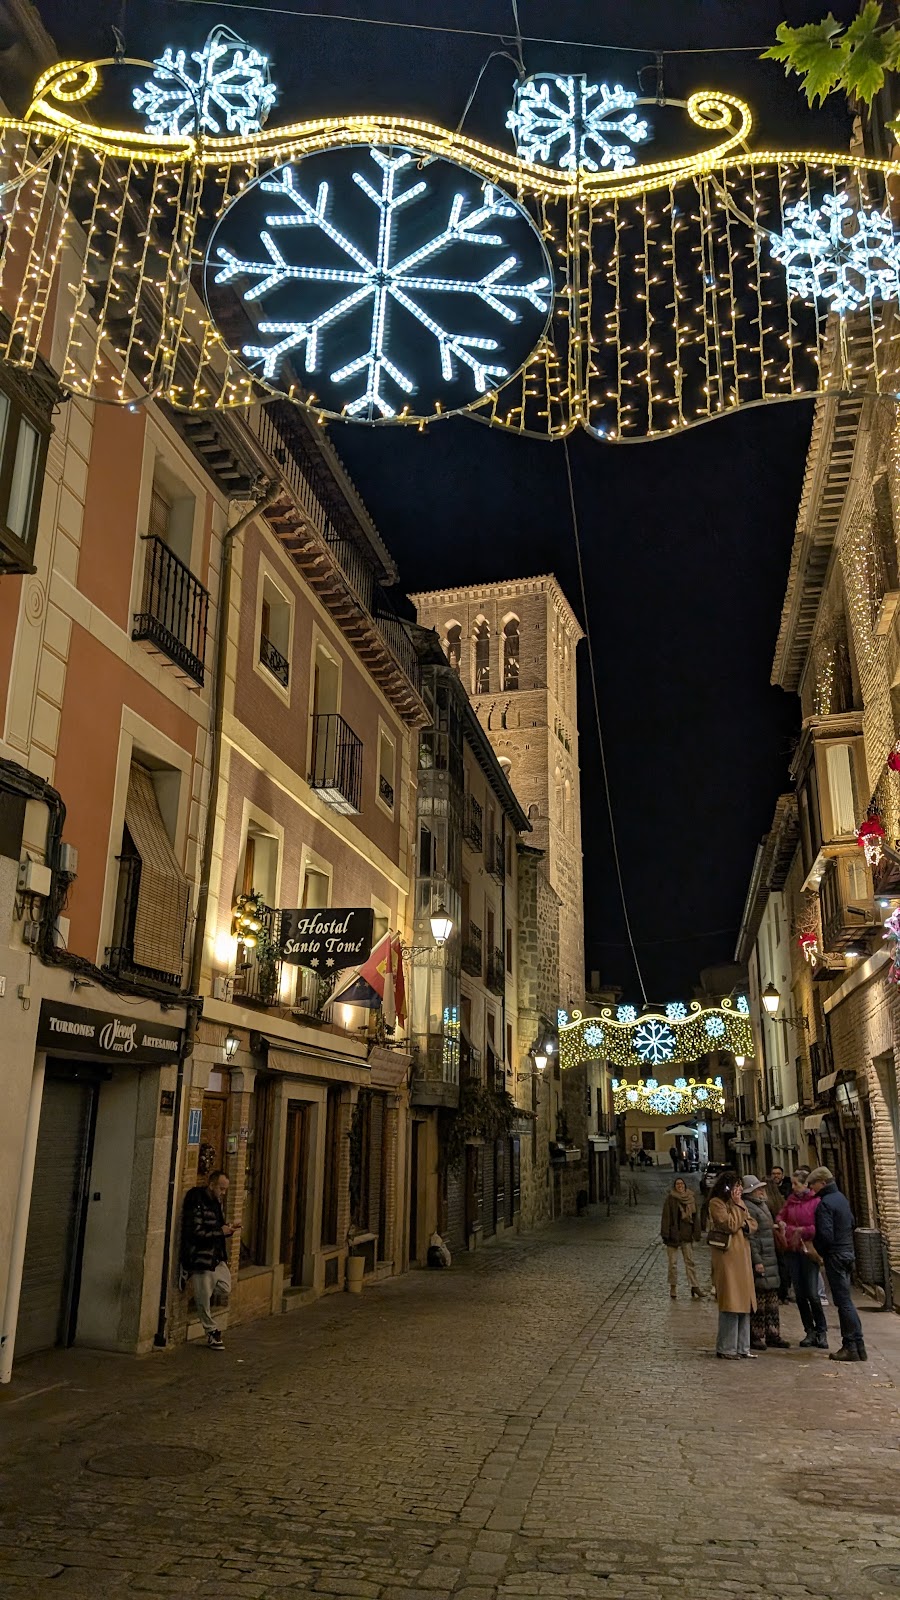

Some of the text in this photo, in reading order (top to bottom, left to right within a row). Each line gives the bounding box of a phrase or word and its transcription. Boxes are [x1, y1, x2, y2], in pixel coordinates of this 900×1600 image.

[297, 911, 355, 935] Hostal
[283, 937, 365, 955] Santo Tomé
[49, 1016, 95, 1038] TURRONES
[141, 1034, 178, 1052] ARTESANOS
